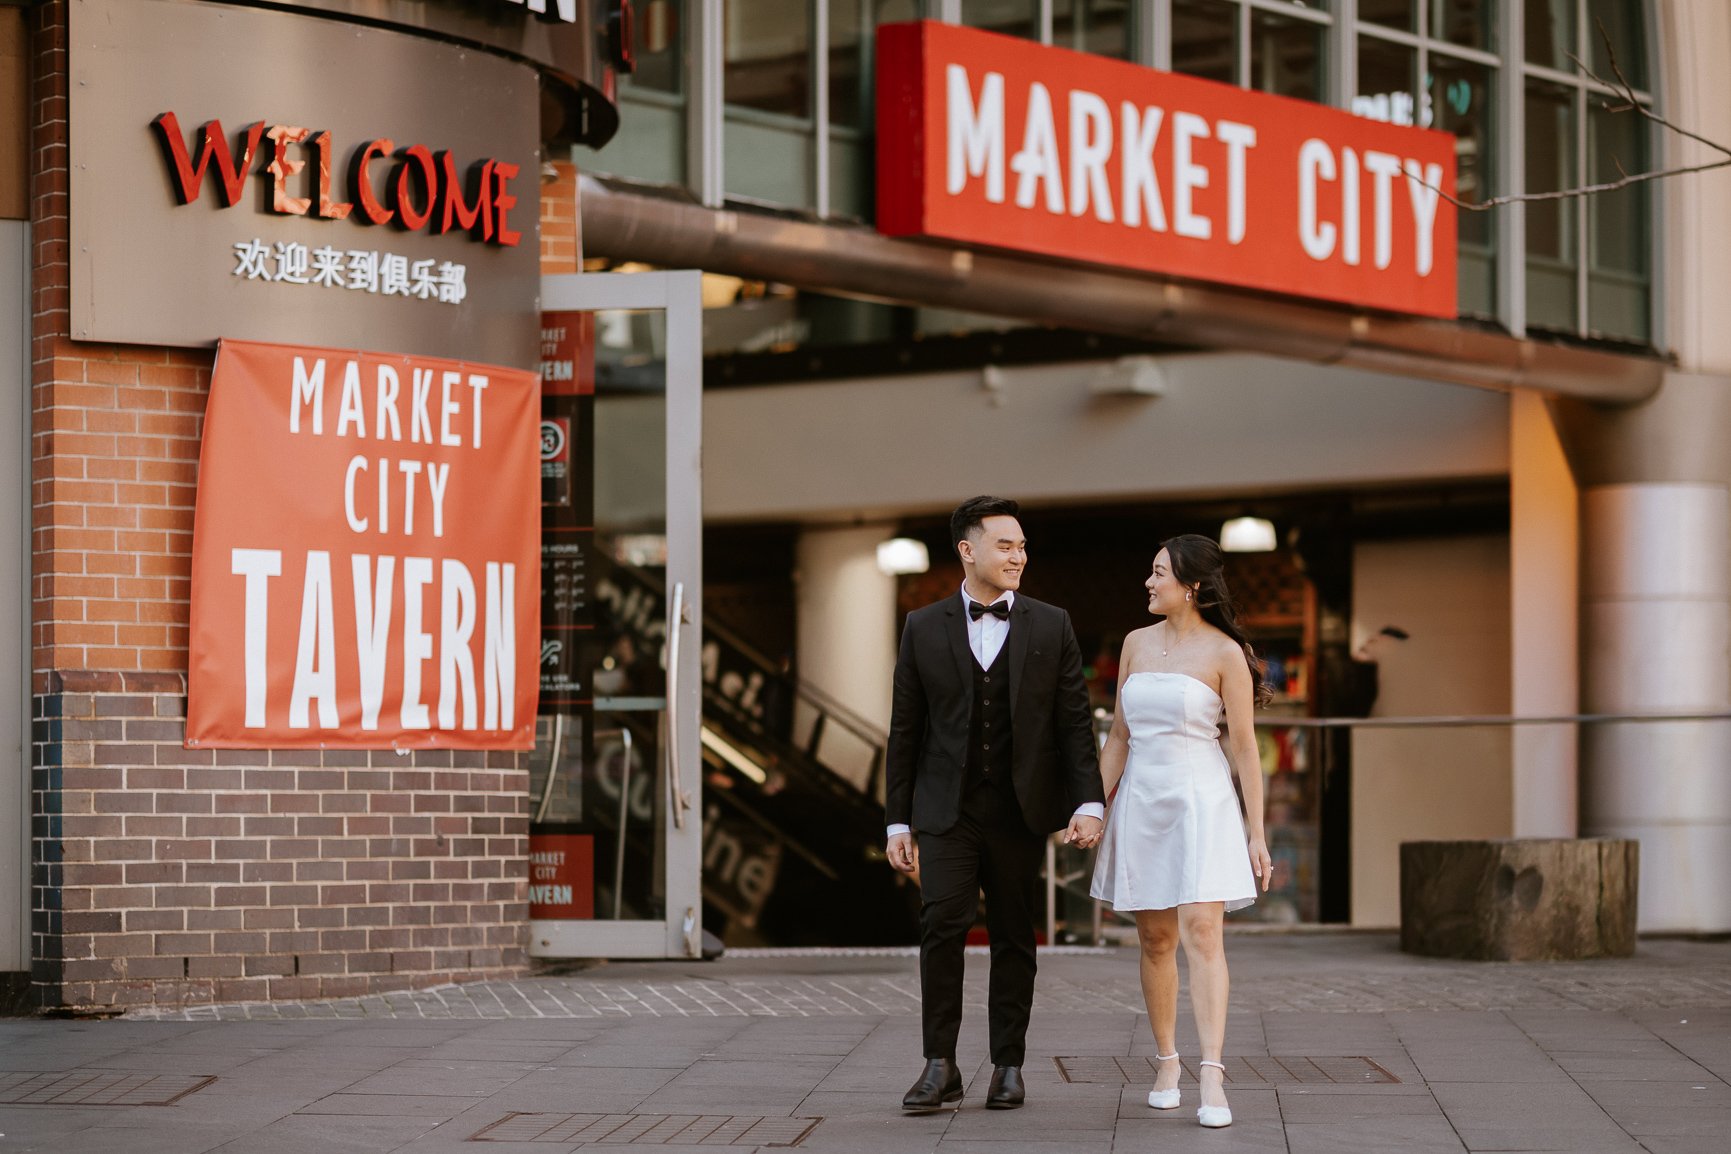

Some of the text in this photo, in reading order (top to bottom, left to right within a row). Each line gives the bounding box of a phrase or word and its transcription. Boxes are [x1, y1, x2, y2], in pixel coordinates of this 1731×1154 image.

[150, 110, 522, 247] WELCOME
[946, 63, 1444, 277] MARKET CITY
[232, 238, 467, 304] 欢迎来到俱乐部
[290, 356, 489, 449] MARKET
[345, 455, 450, 537] CITY
[231, 548, 516, 731] TAVERN
[528, 885, 573, 904] AVERN
